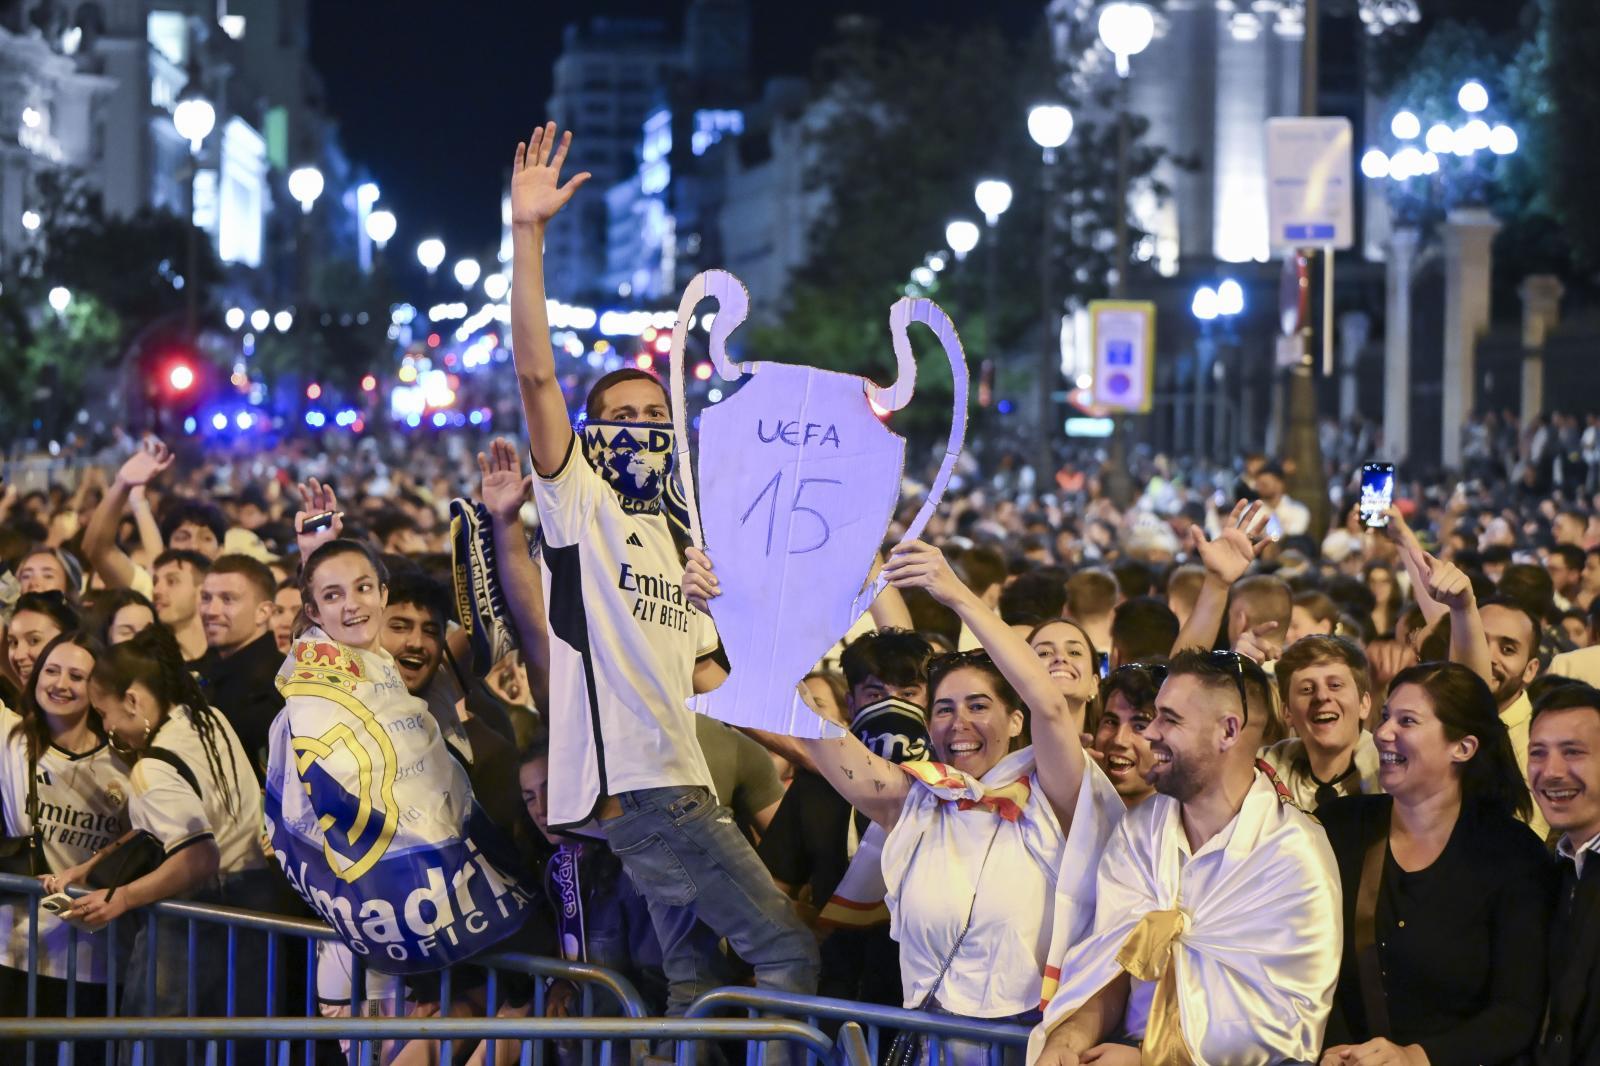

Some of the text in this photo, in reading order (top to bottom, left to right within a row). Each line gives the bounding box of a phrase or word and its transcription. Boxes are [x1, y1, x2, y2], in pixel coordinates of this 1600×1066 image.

[757, 419, 841, 448] UEFA
[740, 469, 843, 558] 15
[457, 563, 473, 636] LONDRES
[469, 540, 490, 617] WEMBLEY
[632, 597, 657, 622] FLY
